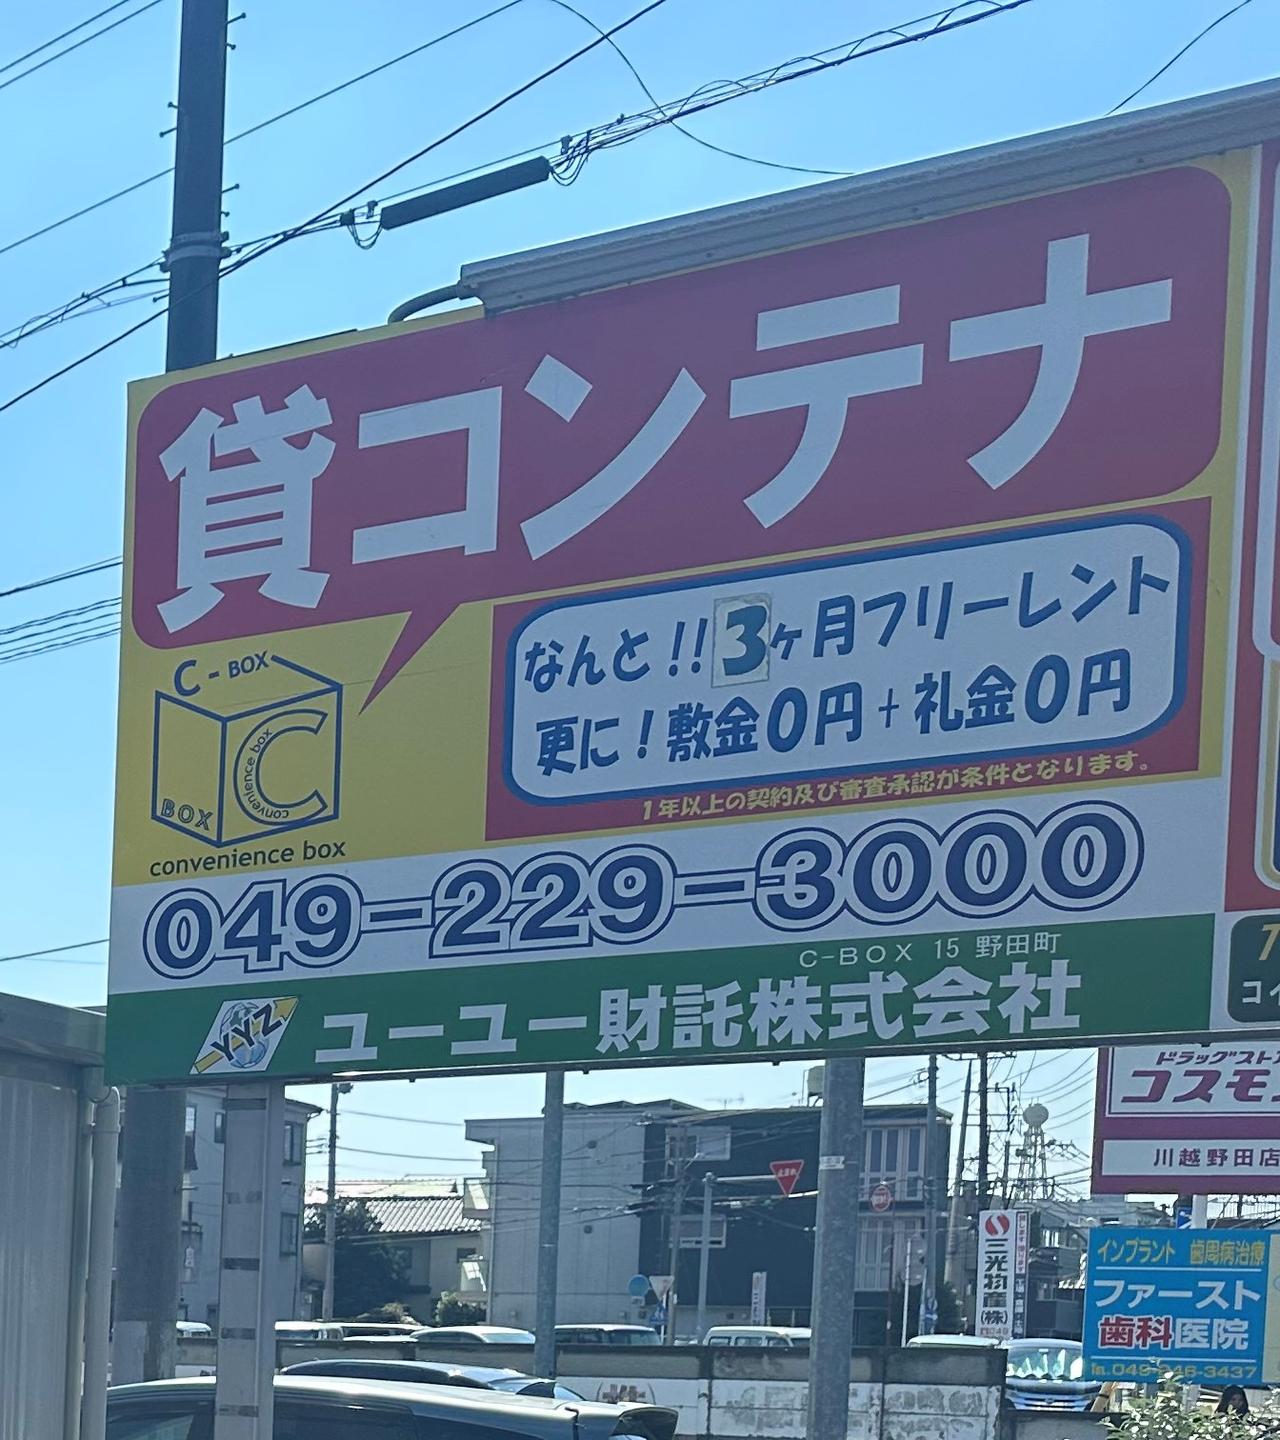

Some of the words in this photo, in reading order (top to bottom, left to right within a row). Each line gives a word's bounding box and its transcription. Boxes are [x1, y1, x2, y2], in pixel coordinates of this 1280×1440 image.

[157, 233, 1172, 634] 貸コンテナ
[643, 750, 1148, 820] 1年以上の契約及び審査承認が条件となります。
[160, 798, 214, 831] BOX
[149, 847, 294, 877] convenience
[302, 839, 346, 861] box
[143, 799, 1145, 980] 049-229-3000
[976, 932, 1062, 959] 野田町
[315, 959, 1082, 1062] ユーユー財託株式会社
[1121, 1069, 1280, 1103] コスモ
[1153, 1148, 1280, 1167] 川越野田店
[1097, 1238, 1175, 1264] インプラント
[1093, 1280, 1262, 1311] ファースト
[1098, 1314, 1250, 1350] 歯科医院
